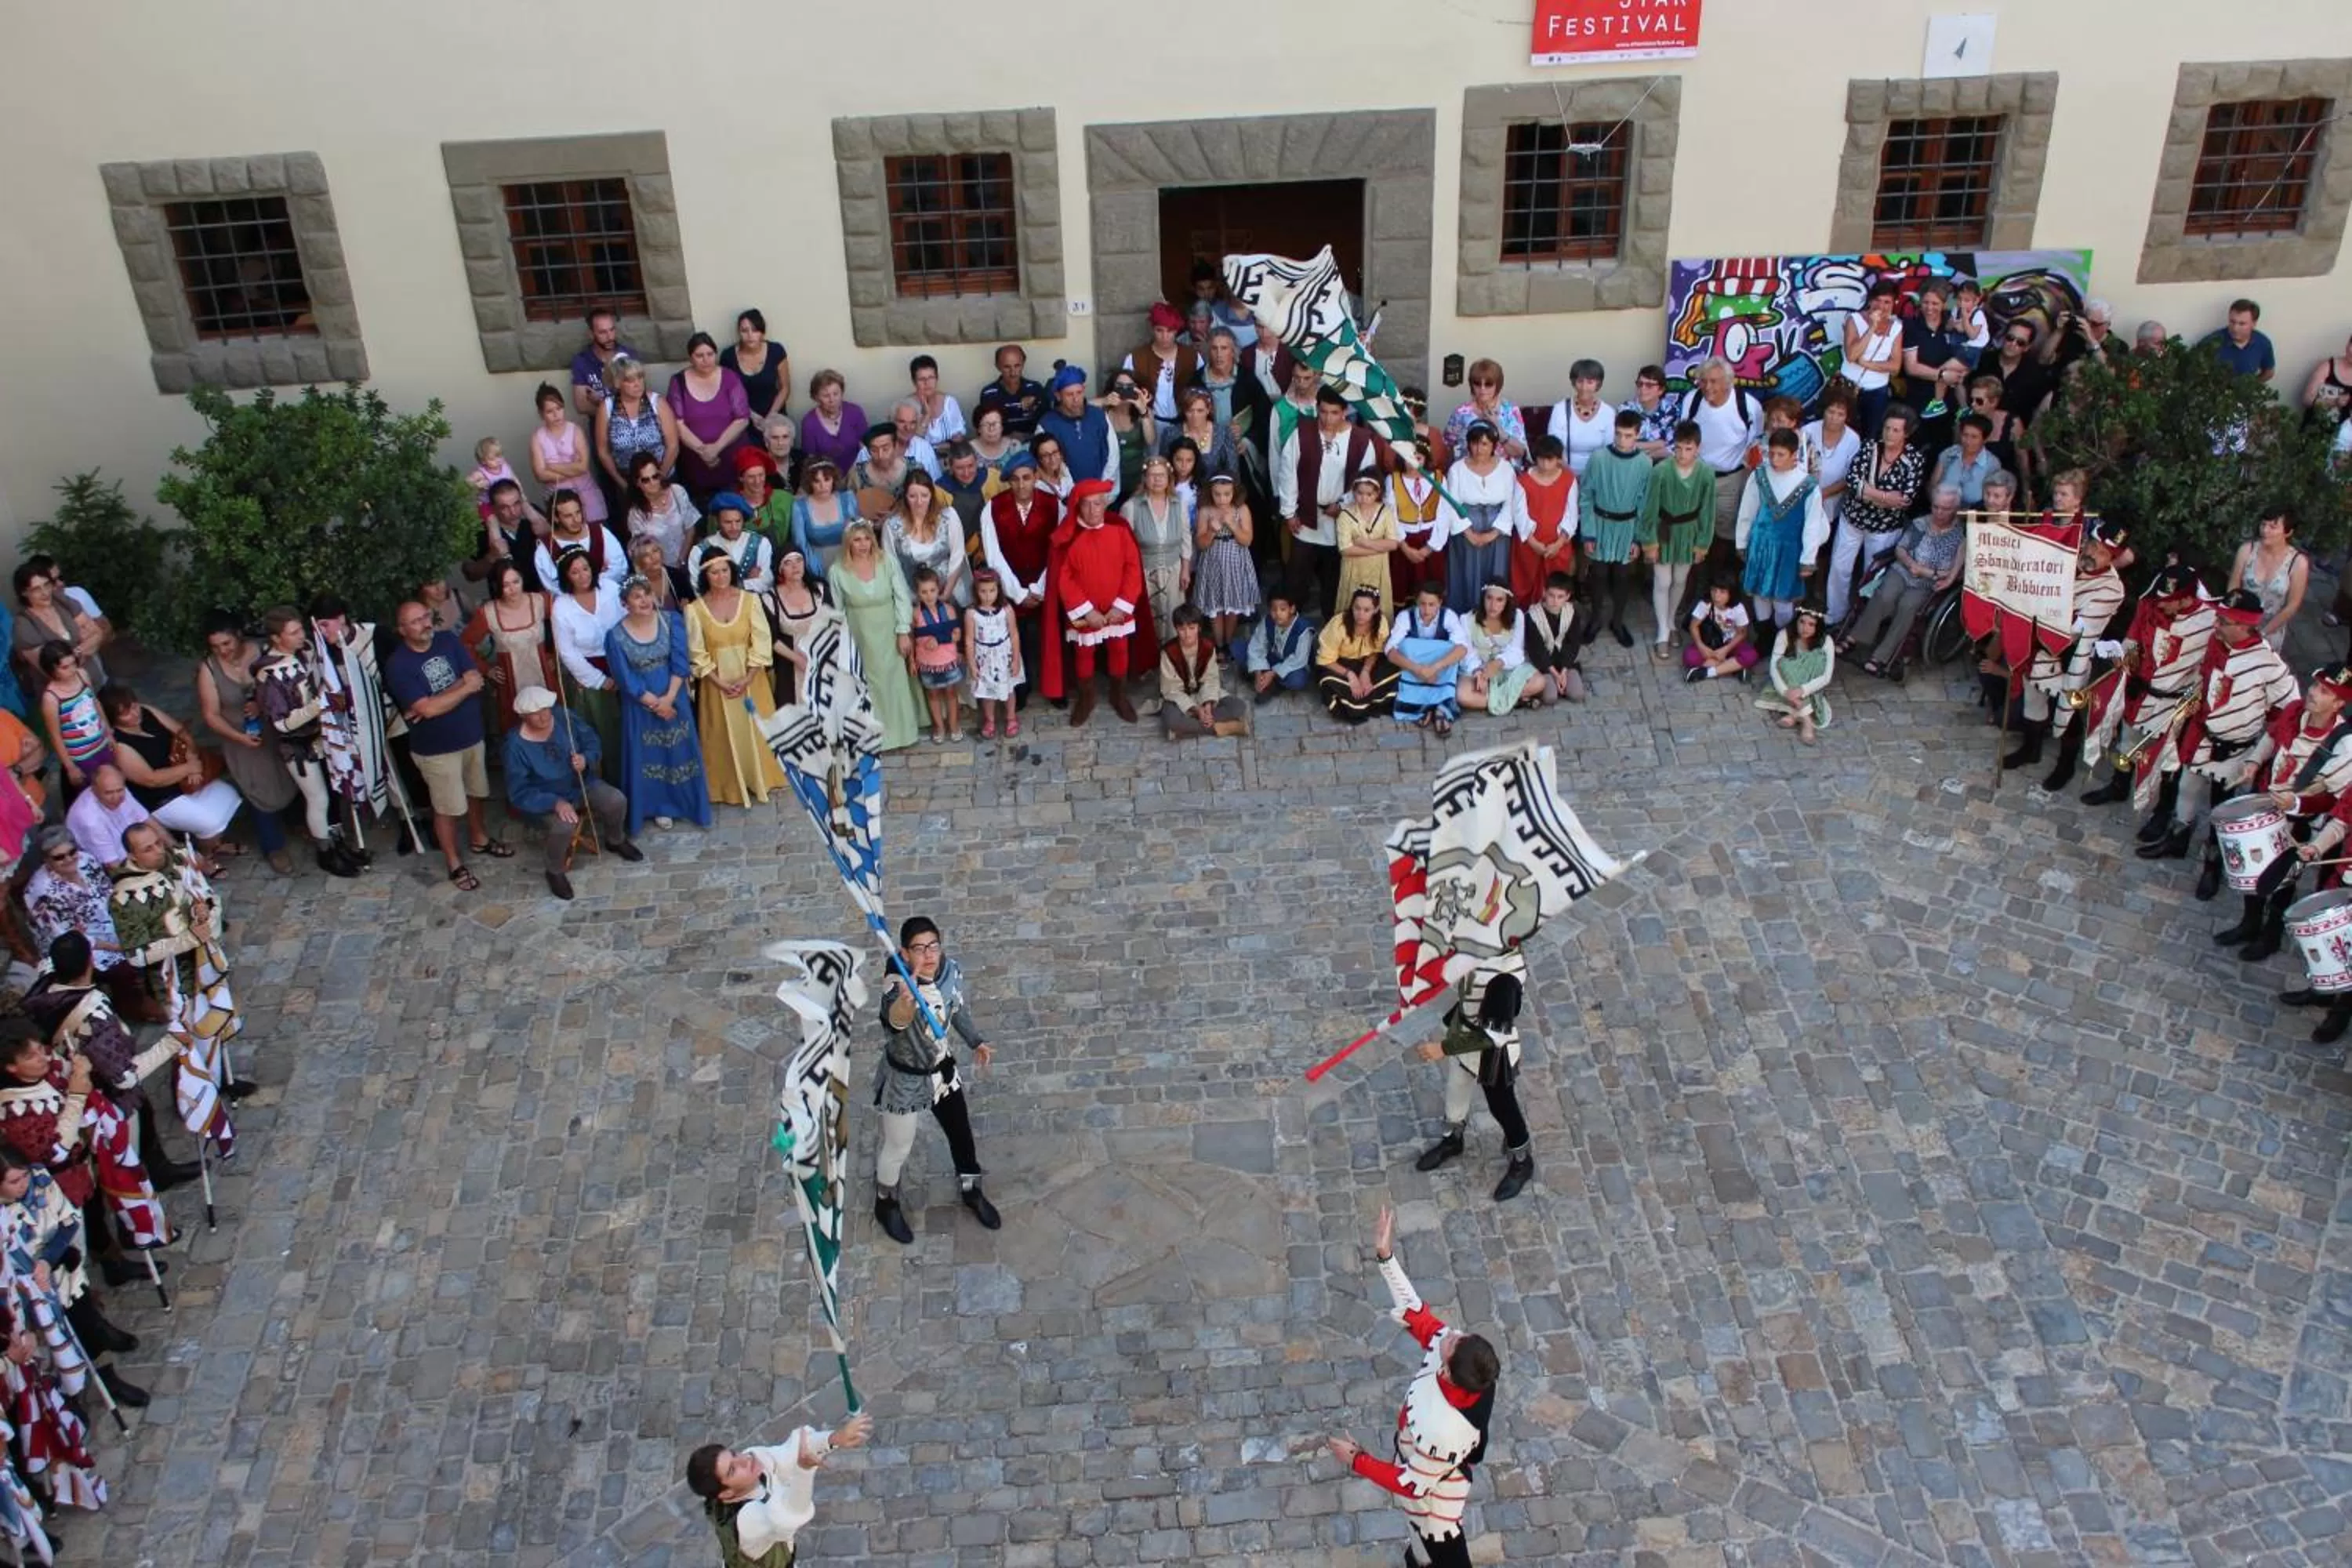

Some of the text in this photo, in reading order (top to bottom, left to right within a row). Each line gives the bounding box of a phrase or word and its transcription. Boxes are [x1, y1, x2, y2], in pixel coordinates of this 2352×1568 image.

[1976, 532, 2020, 550] Musici
[1973, 553, 2064, 574] Sbandieratori
[2005, 575, 2061, 597] Bibbiena
